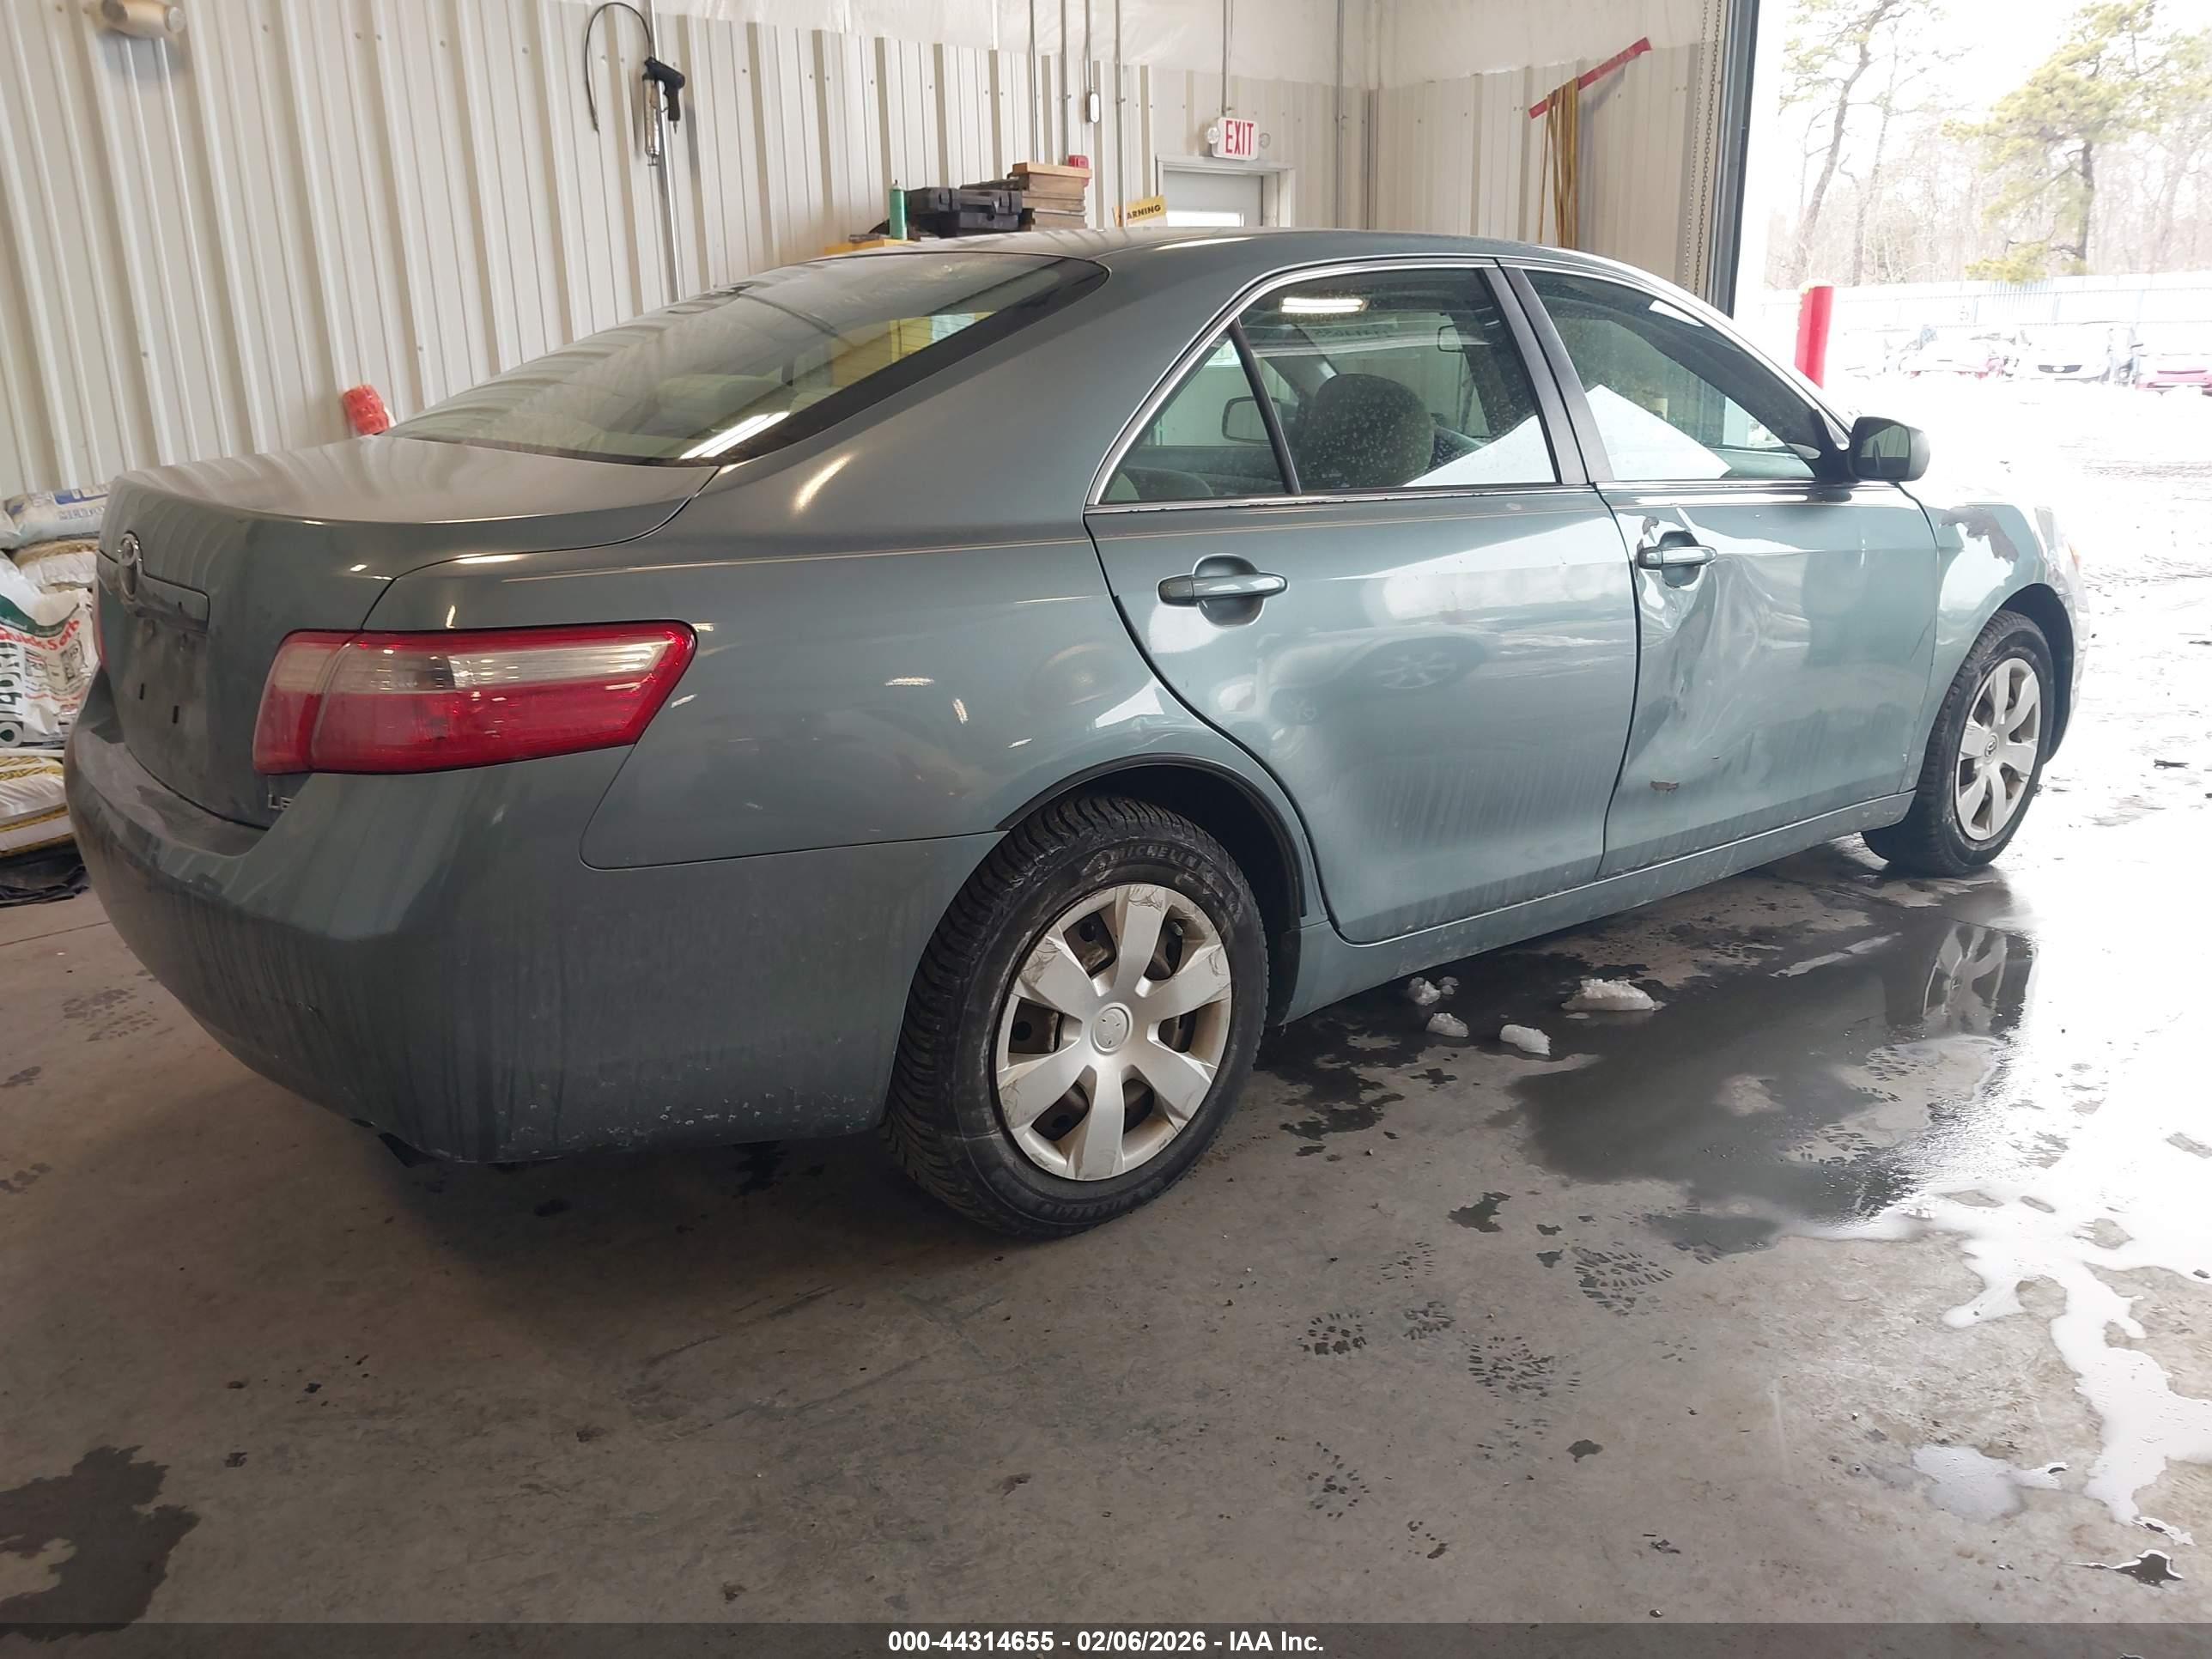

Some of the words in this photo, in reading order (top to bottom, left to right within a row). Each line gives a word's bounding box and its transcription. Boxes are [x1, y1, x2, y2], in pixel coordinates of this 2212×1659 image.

[1225, 120, 1254, 156] EXIT
[1126, 204, 1161, 220] ARNING
[1115, 844, 1197, 868] MICHELIN
